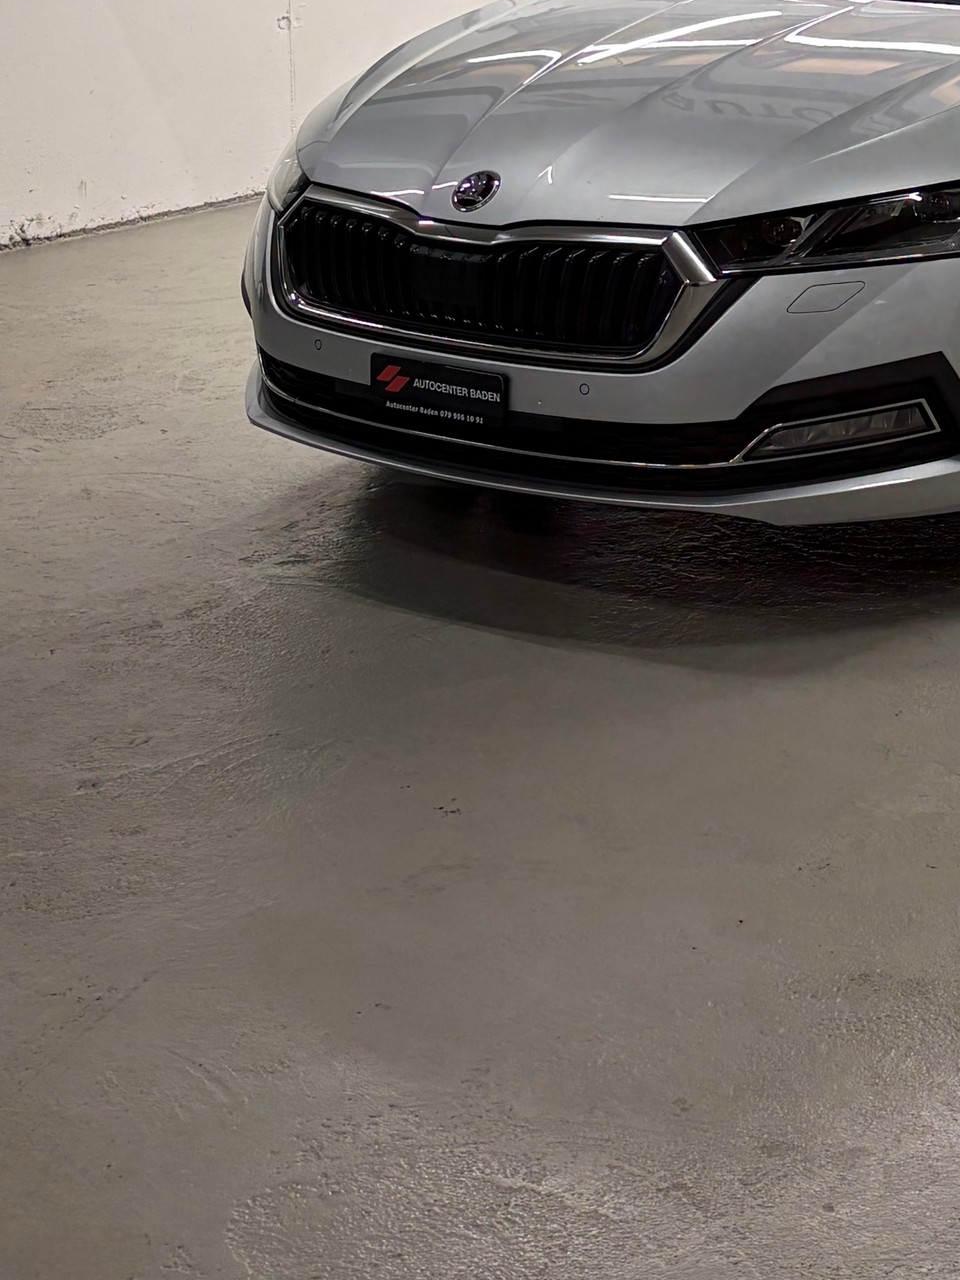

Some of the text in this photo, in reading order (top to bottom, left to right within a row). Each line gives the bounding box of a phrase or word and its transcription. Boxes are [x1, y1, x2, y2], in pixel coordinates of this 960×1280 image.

[413, 378, 501, 402] AUTOCENTER BADEN
[386, 400, 419, 413] Autocenter
[419, 406, 439, 417] Baden
[440, 410, 452, 419] 079
[466, 415, 475, 423] 10
